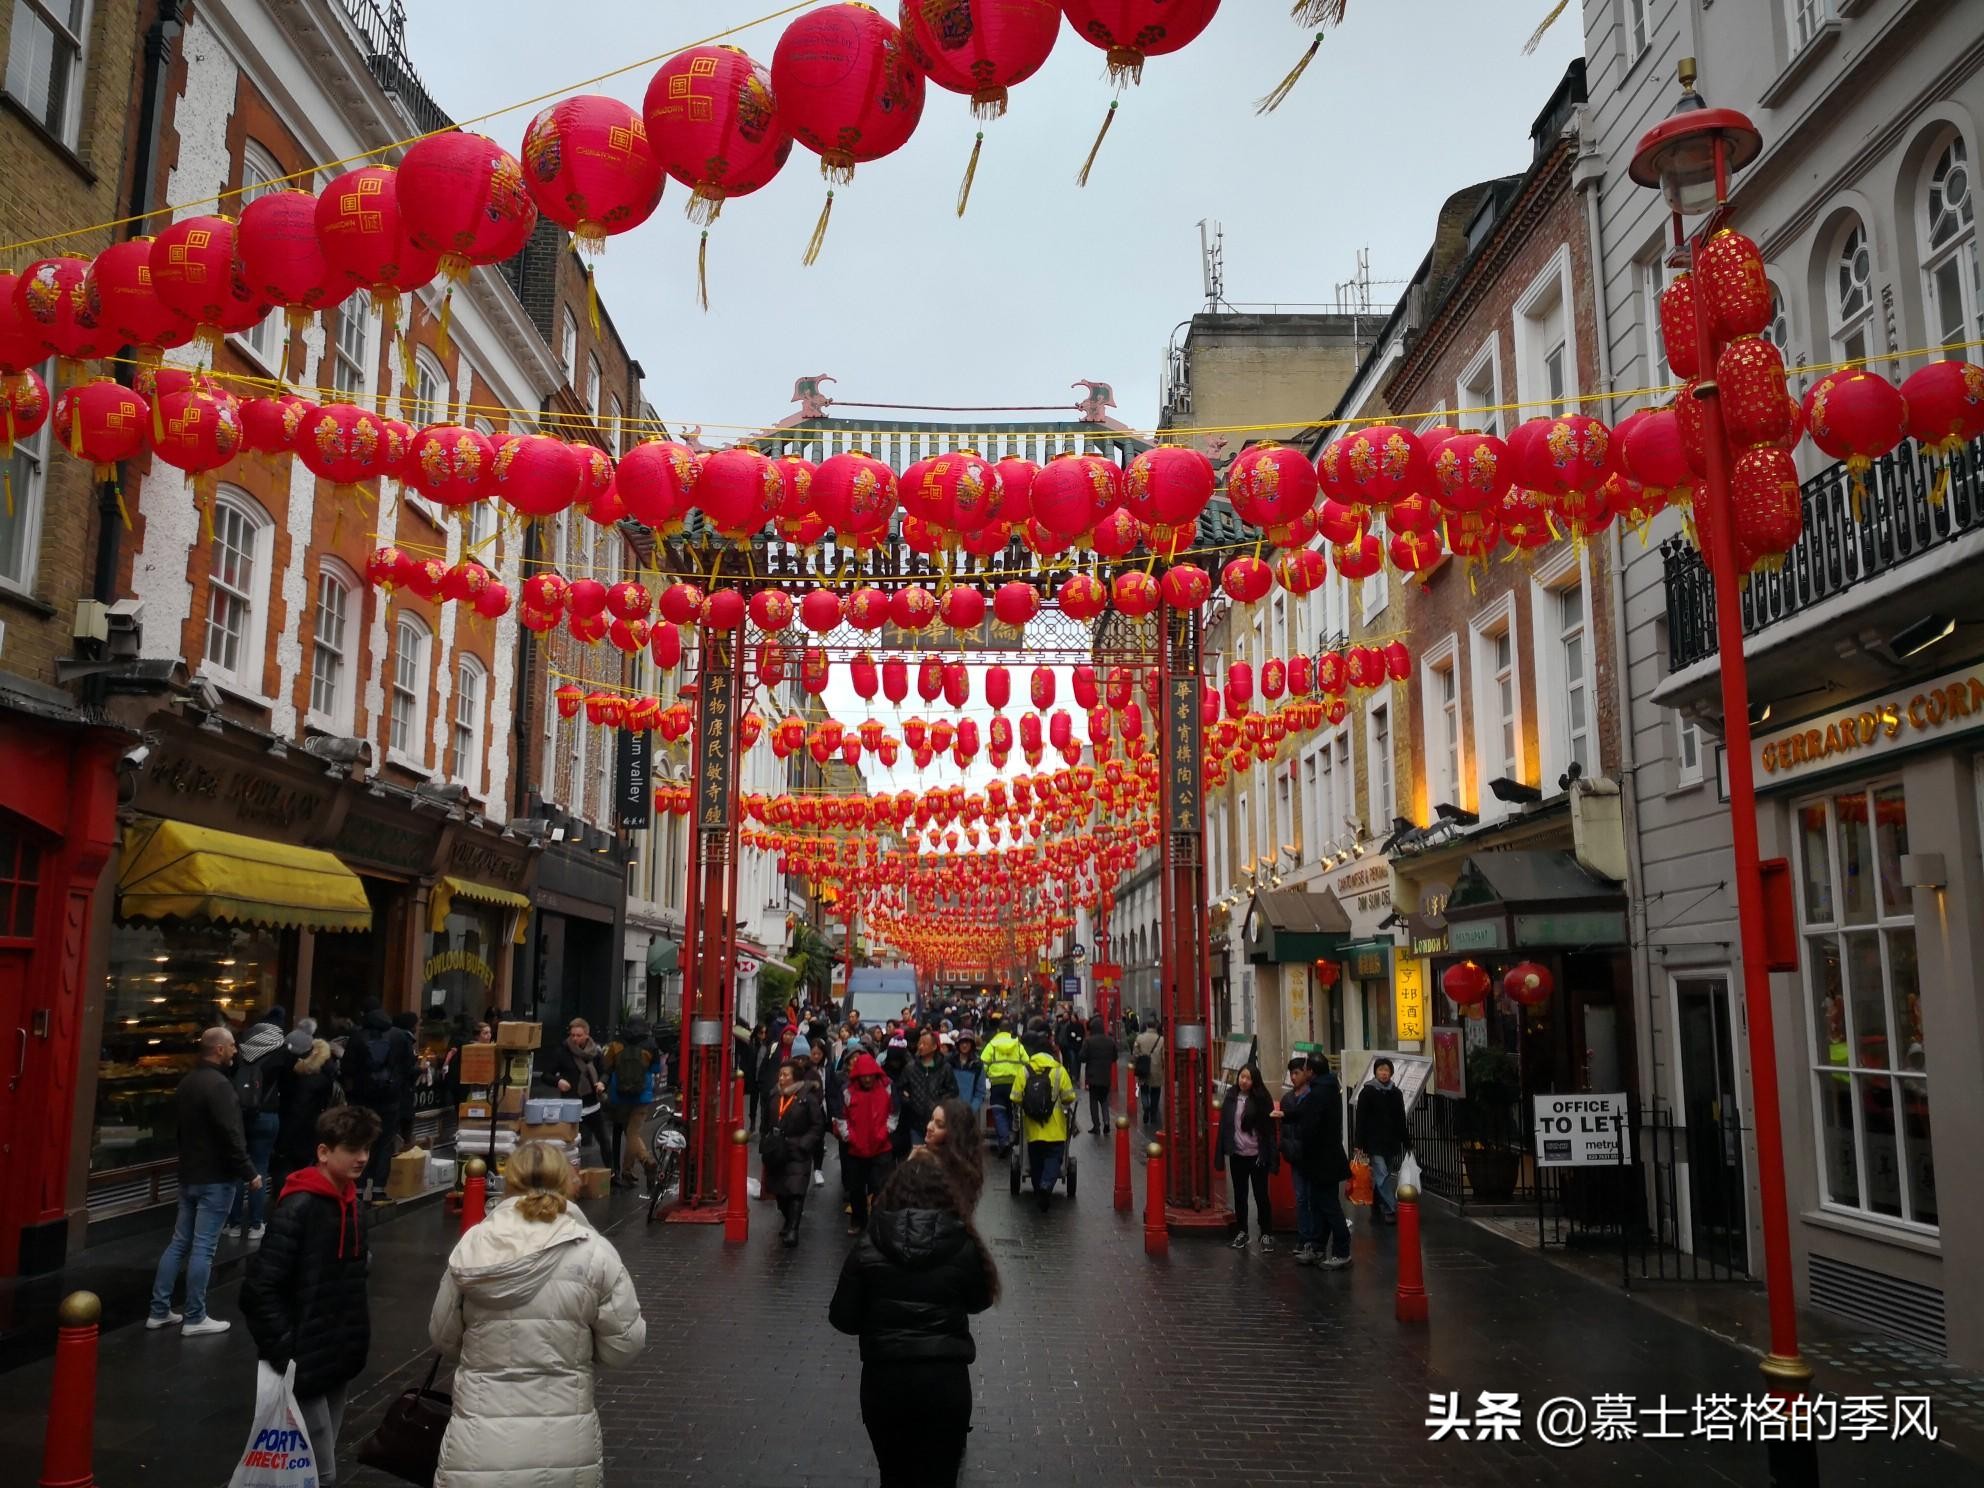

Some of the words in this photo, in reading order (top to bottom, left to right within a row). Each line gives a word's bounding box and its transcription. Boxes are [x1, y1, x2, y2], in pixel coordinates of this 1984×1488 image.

[1762, 702, 1901, 773] GERRARD'S
[627, 761, 644, 803] valley
[1368, 891, 1380, 911] SUM
[1413, 937, 1441, 954] LONDON
[424, 950, 465, 984] OWLOON
[1552, 1100, 1610, 1113] OFFICE
[1540, 1116, 1572, 1134] TO
[1581, 1115, 1624, 1133] LET
